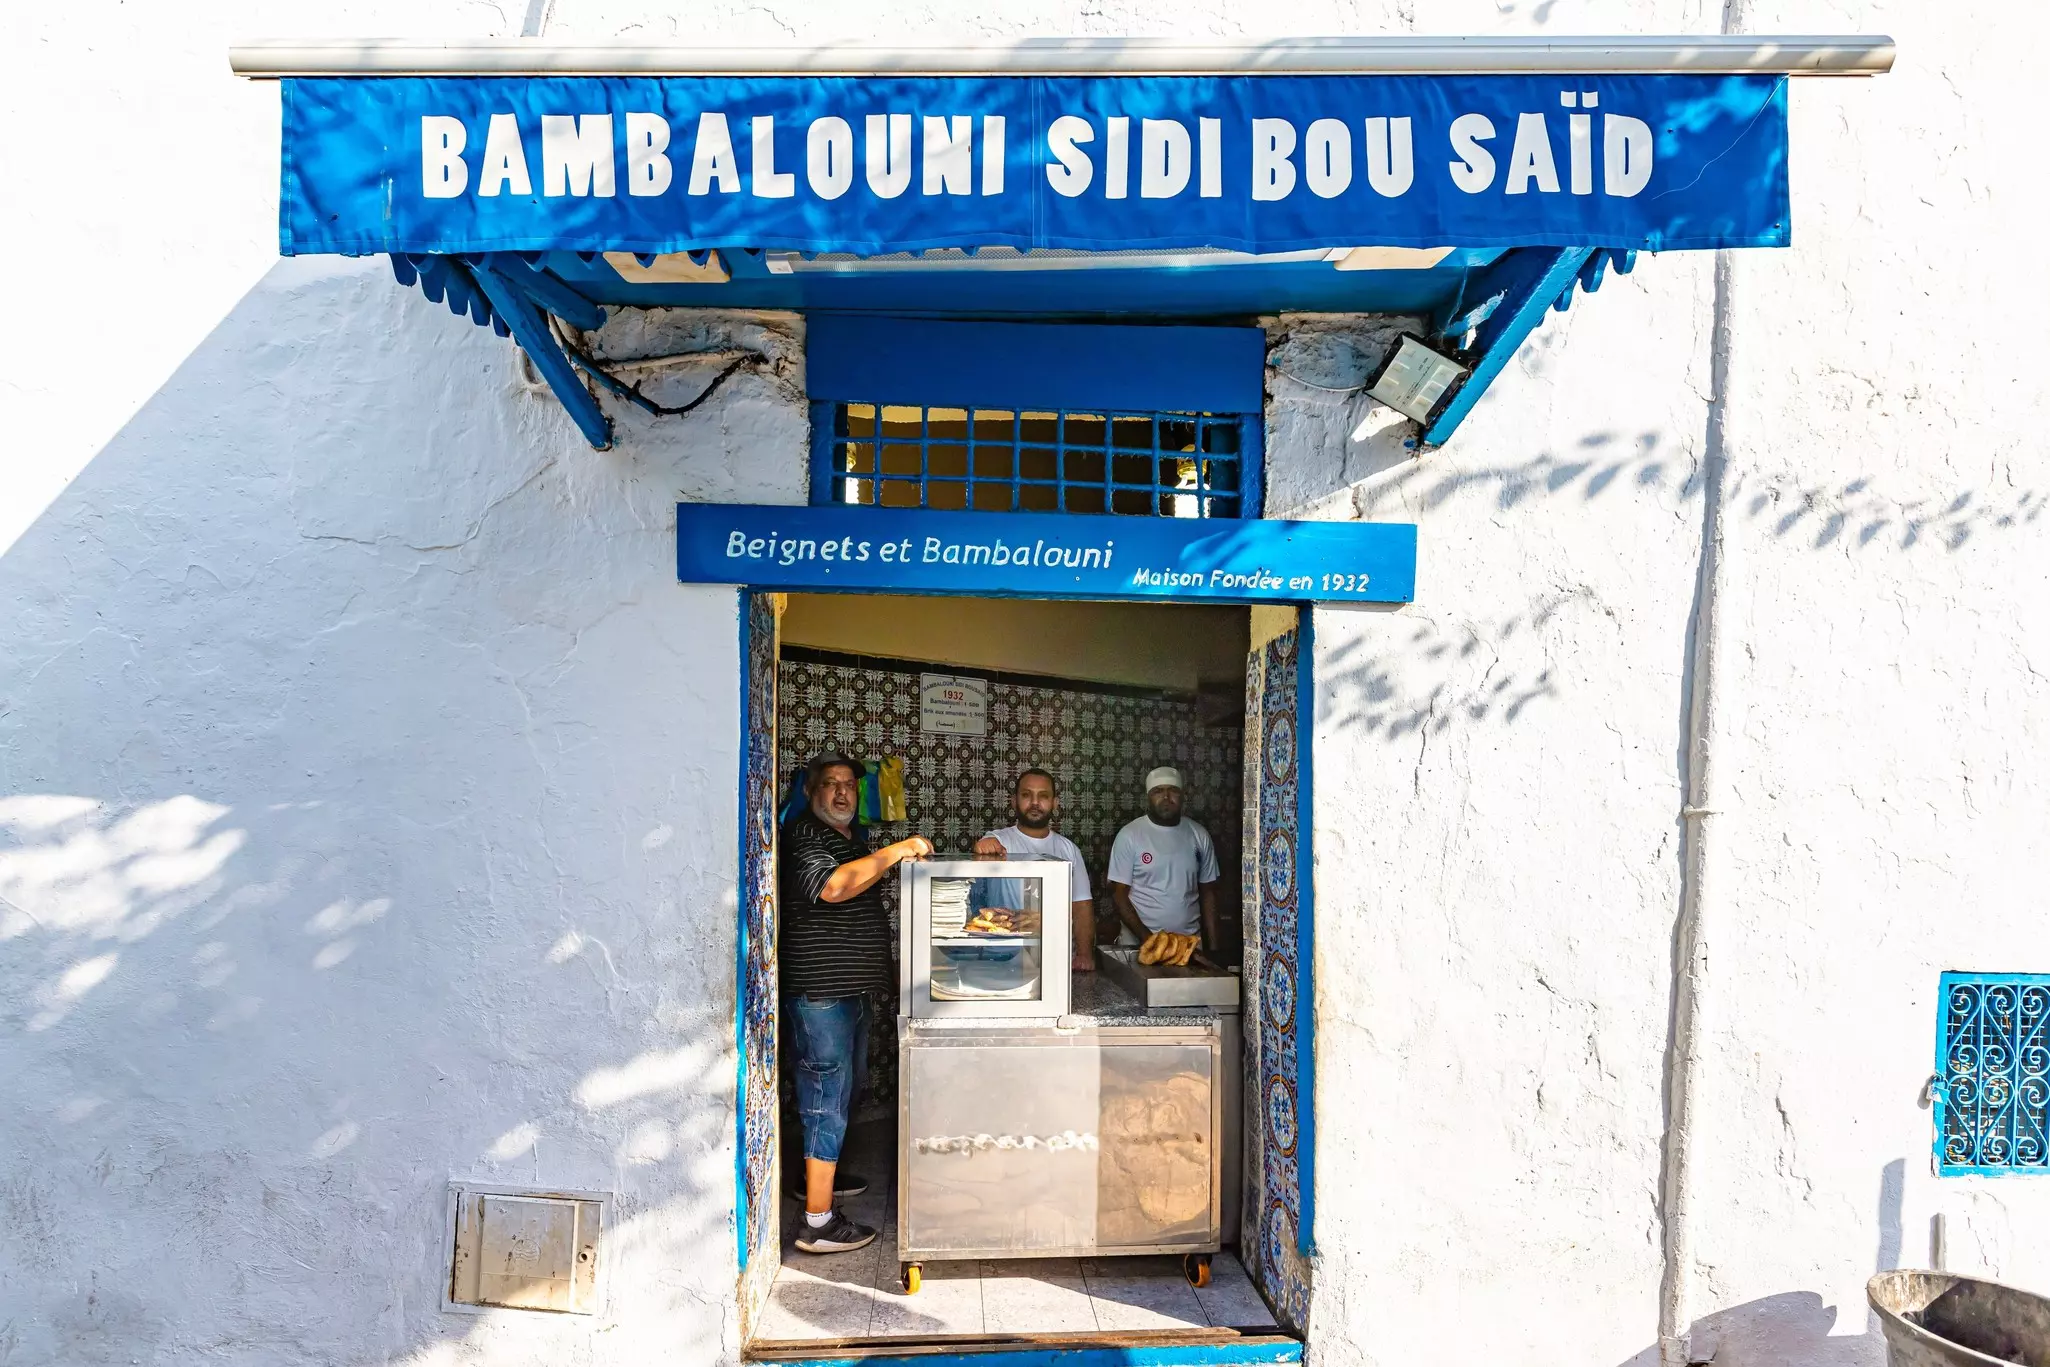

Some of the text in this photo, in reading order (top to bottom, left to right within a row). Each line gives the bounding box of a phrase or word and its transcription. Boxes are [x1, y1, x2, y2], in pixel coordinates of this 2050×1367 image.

[421, 90, 1655, 201] BAMBALOUNI SIDI BOU SAÏD
[726, 530, 1114, 569] Beignets et Bambalouni
[1132, 567, 1370, 593] Maison Fondée en 1932
[943, 690, 964, 700] 1932
